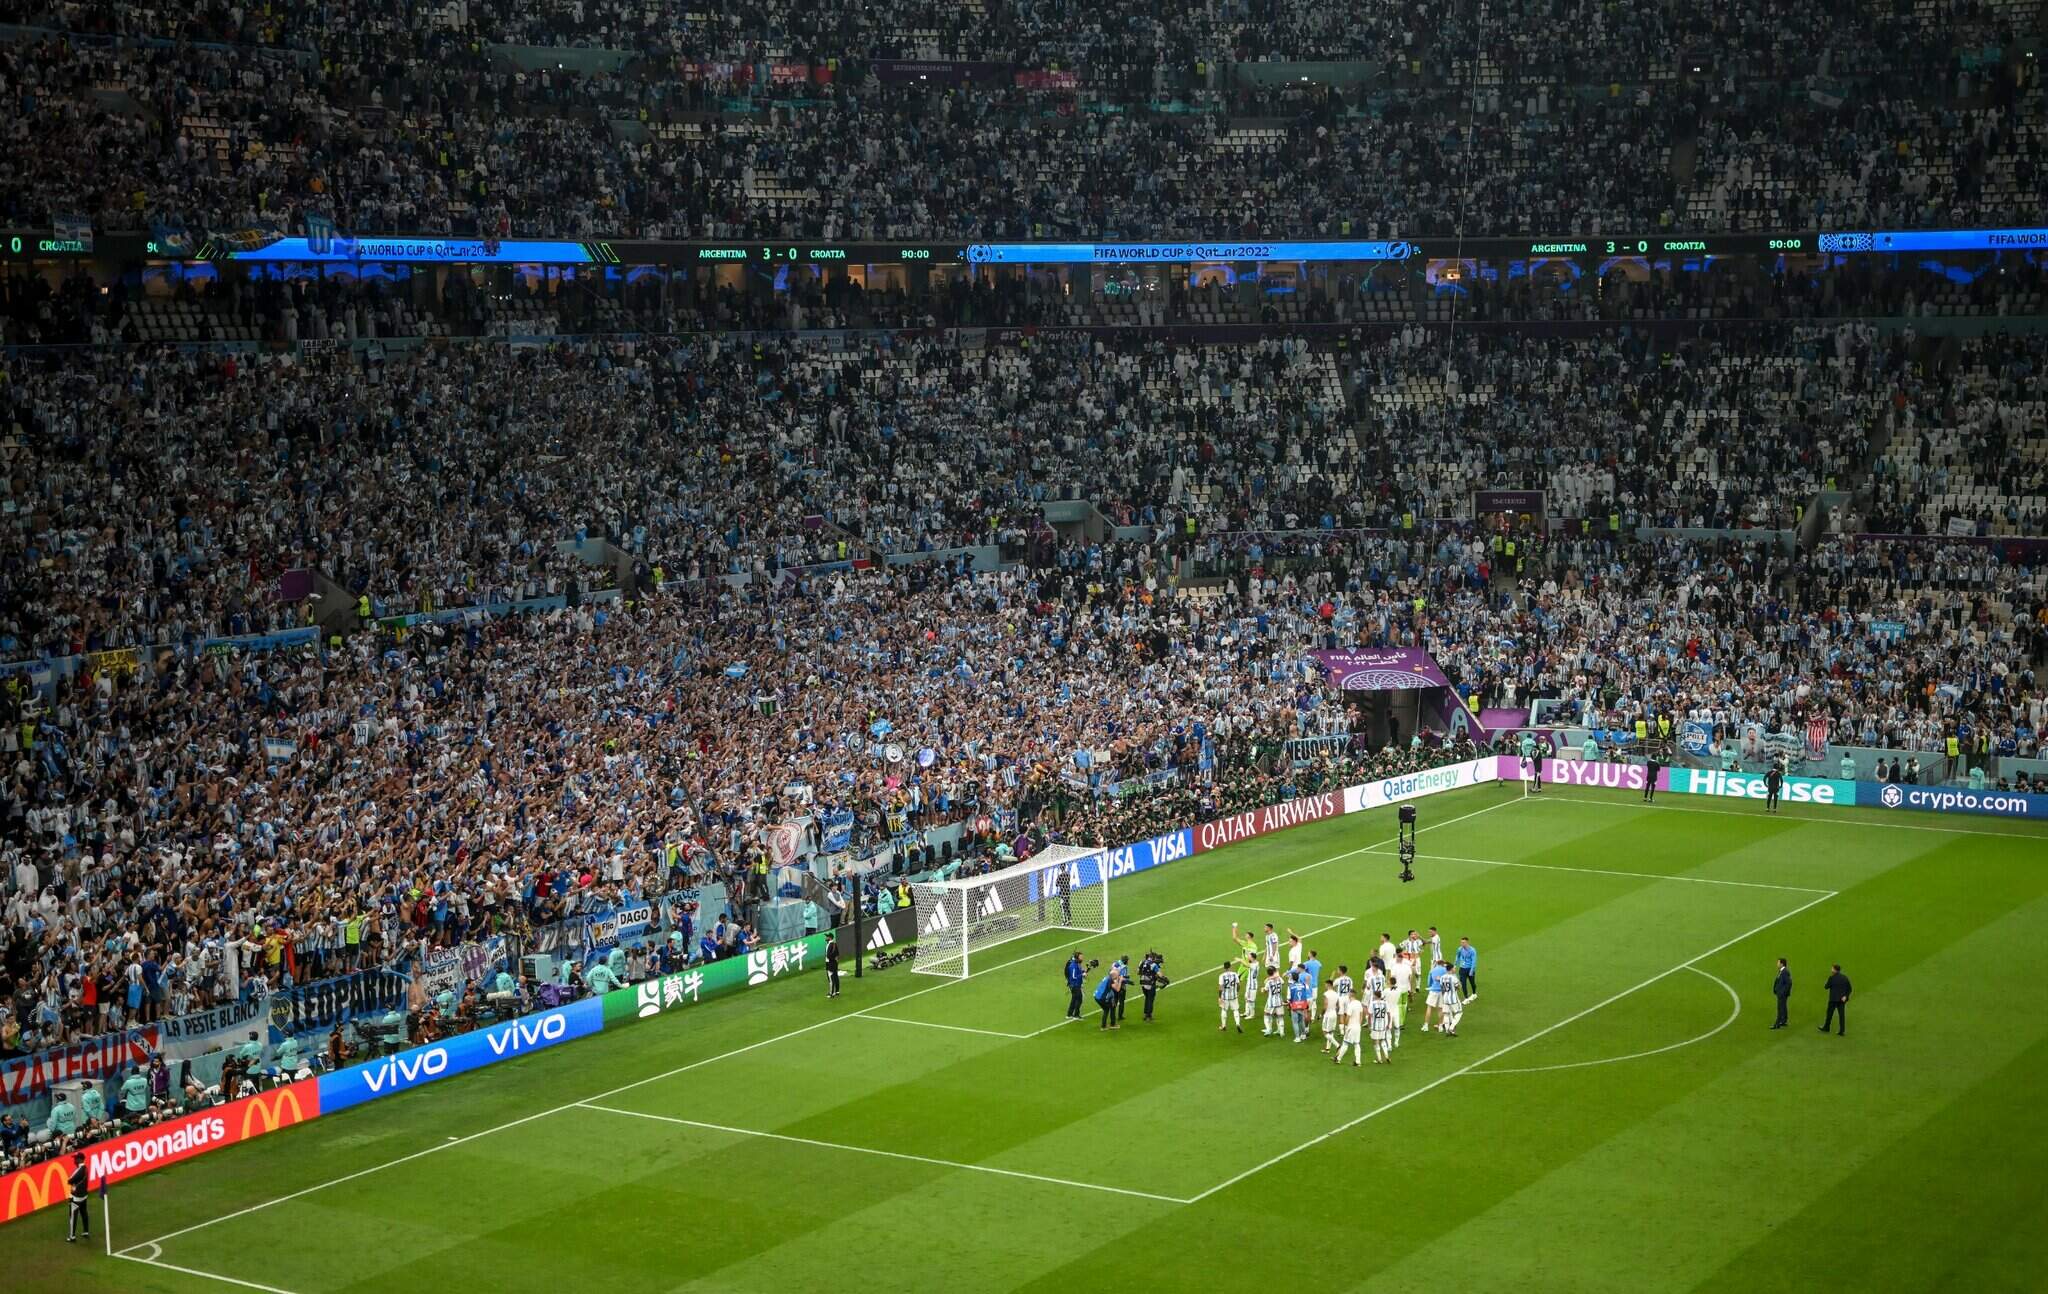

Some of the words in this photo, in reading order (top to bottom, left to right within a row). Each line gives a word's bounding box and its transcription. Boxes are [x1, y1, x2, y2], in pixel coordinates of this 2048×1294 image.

[11, 237, 22, 252] 0
[369, 245, 405, 257] WORLD
[406, 245, 425, 257] CUP
[1094, 248, 1117, 258] FIFA
[1118, 248, 1160, 258] WORLD
[1162, 247, 1184, 258] CUP
[1531, 243, 1587, 253] ARGENTINA
[1606, 241, 1616, 253] 3
[1638, 240, 1648, 253] 0
[1663, 241, 1706, 251] CROATIA
[1769, 239, 1801, 249] 90:00
[1989, 234, 2016, 245] FIFA
[699, 250, 747, 259] ARGENTINA
[763, 248, 771, 260] 3
[789, 248, 797, 260] 0
[810, 250, 846, 259] CROATIA
[901, 250, 930, 259] 90:00
[1383, 768, 1460, 802] QatarEnergy
[1551, 758, 1643, 790] BYJU'S
[1909, 791, 2027, 813] crypto.com
[1201, 815, 1257, 850] QATAR
[1263, 792, 1334, 832] AIRWAYS
[1148, 831, 1187, 865] VISA
[1094, 846, 1136, 881] VISA
[620, 908, 649, 925] DAGO
[770, 941, 809, 977] 蒙牛
[663, 970, 704, 1009] 蒙牛
[1223, 979, 1236, 989] 24
[164, 1021, 180, 1037] LA
[184, 1012, 217, 1036] PESTE
[486, 1014, 566, 1055] vivo
[361, 1048, 448, 1092] vivo
[89, 1117, 225, 1182] McDonald's
